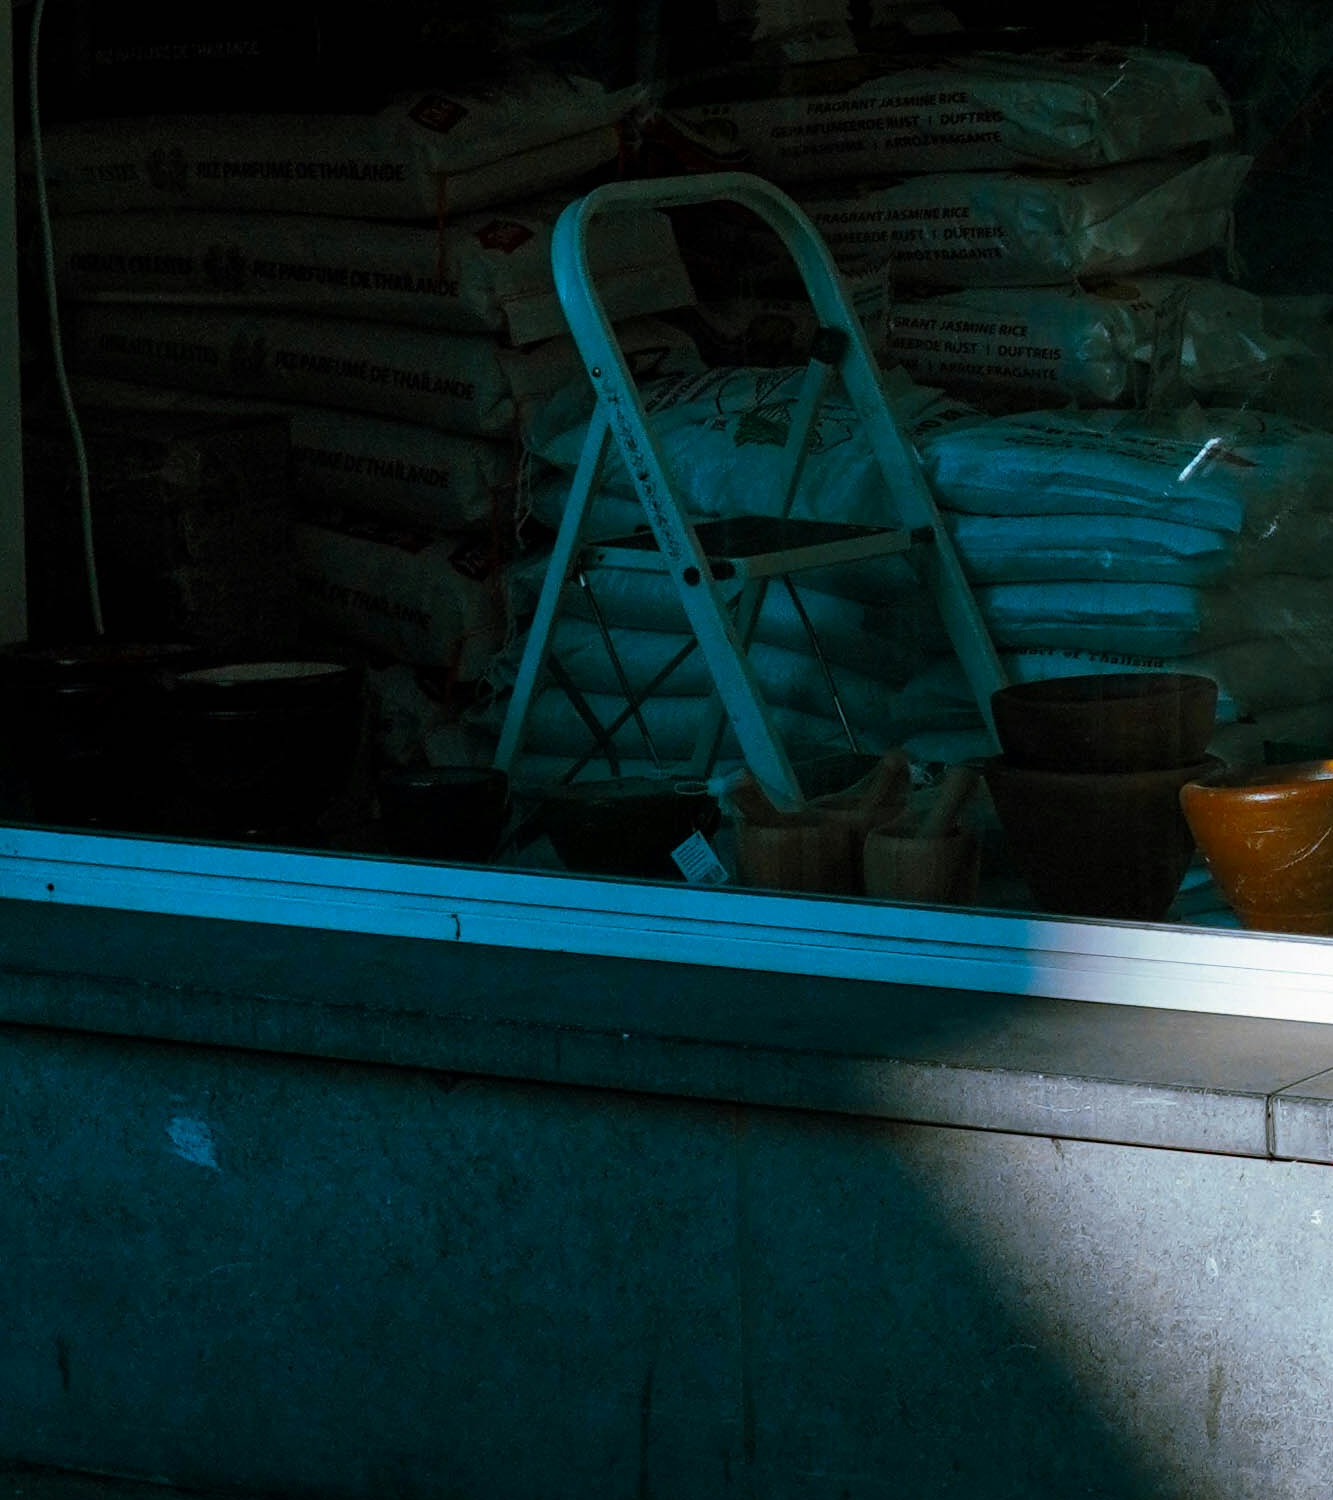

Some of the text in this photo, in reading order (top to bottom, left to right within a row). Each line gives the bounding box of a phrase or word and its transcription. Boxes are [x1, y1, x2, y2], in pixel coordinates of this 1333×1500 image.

[807, 91, 968, 114] FRAGRANT JASMINE RICE
[197, 161, 221, 179] RIZ
[296, 161, 320, 180] DE
[816, 206, 970, 225] FRAGRANT JASMINE RICE
[943, 226, 1005, 240] DUFTREIS
[253, 260, 277, 279] RIZ
[349, 269, 373, 288] DE
[939, 320, 997, 335] JASMINE
[998, 324, 1029, 337] RICE
[997, 344, 1063, 361] DUFTREIS
[369, 365, 391, 383] DE
